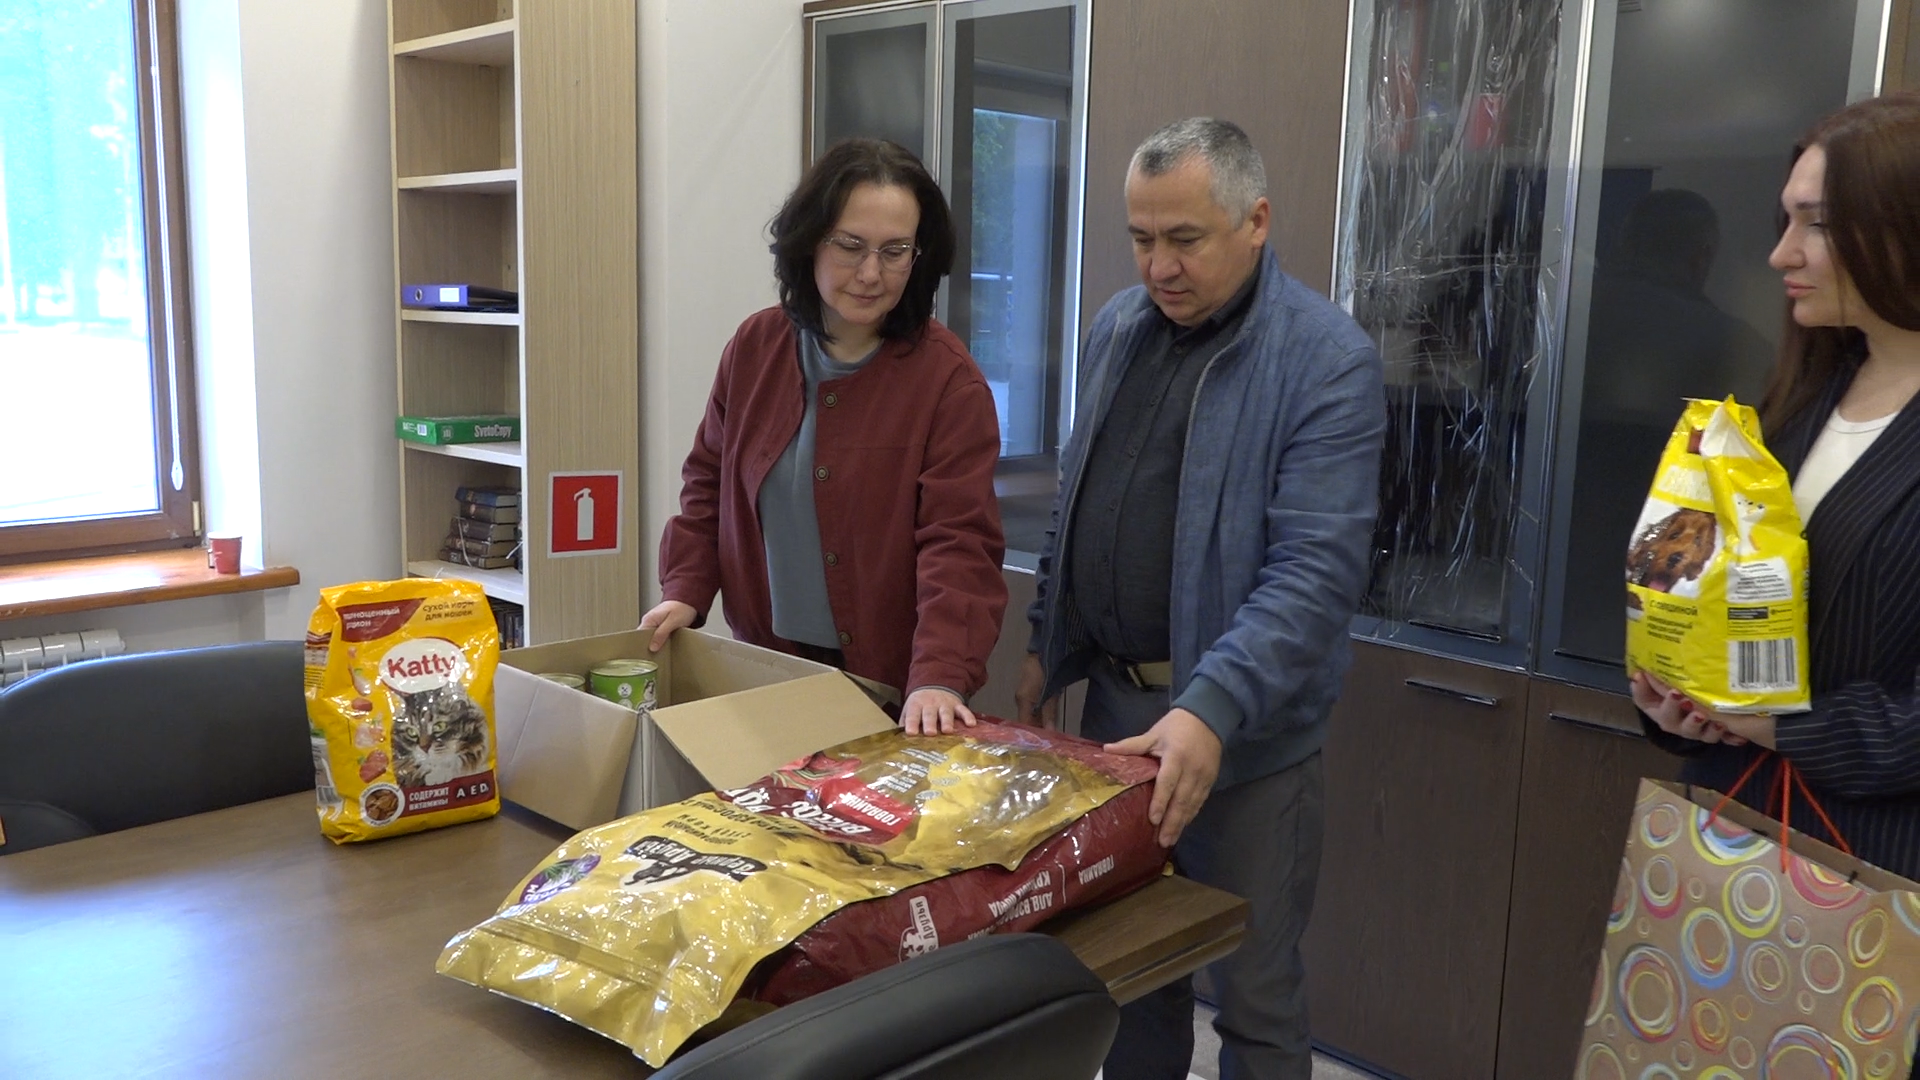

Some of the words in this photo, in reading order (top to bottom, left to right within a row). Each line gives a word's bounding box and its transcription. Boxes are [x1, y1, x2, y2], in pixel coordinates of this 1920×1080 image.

[474, 424, 512, 438] SvetoCopy
[387, 652, 457, 679] Katty
[409, 787, 449, 802] СОДЕРЖИТ
[456, 788, 466, 798] A
[470, 785, 477, 795] E
[1078, 854, 1115, 885] ГОВЯДИНА
[1030, 890, 1053, 910] ДЛЯ
[915, 900, 936, 940] Друзья
